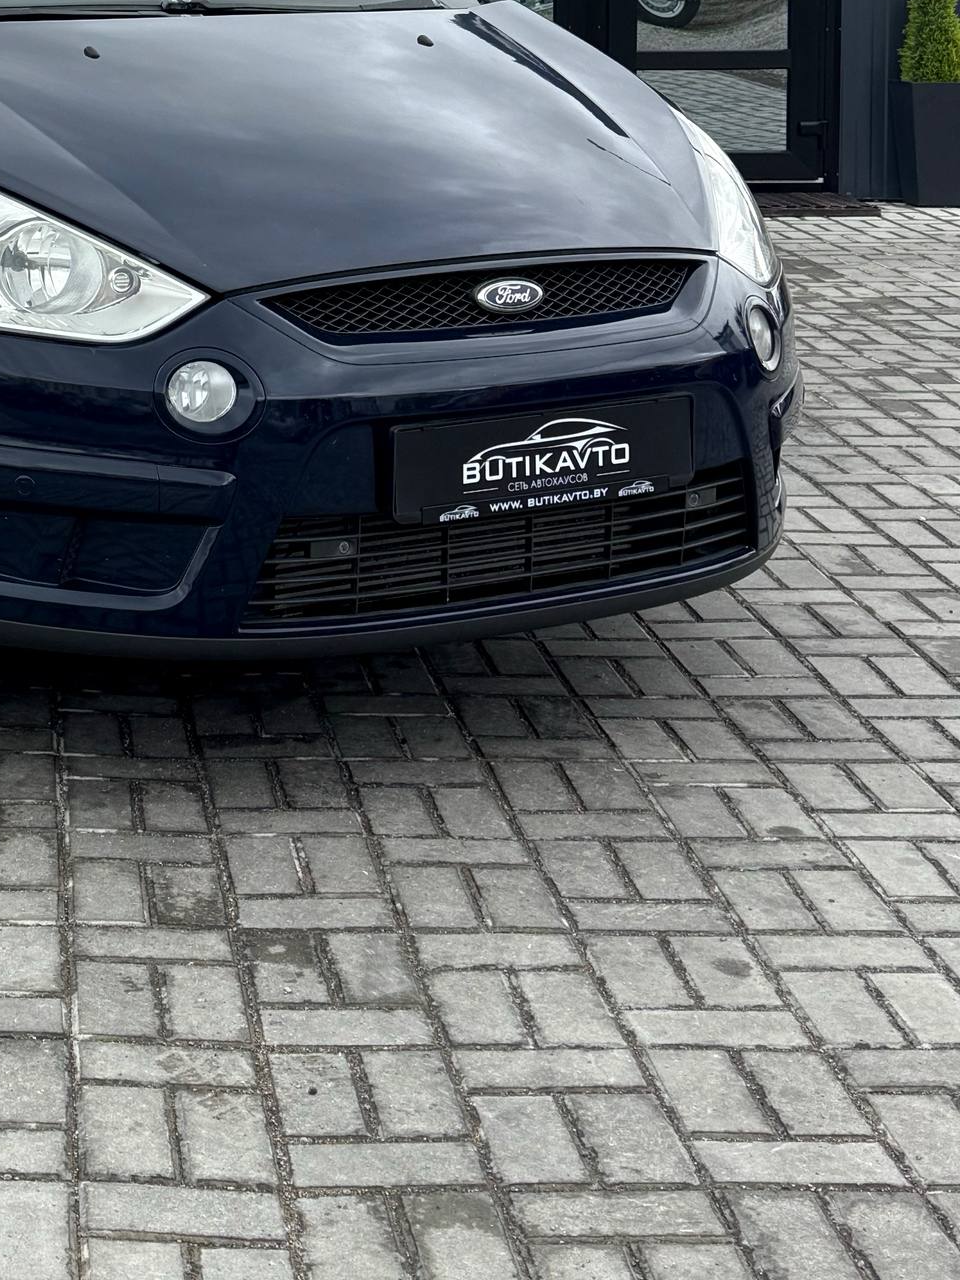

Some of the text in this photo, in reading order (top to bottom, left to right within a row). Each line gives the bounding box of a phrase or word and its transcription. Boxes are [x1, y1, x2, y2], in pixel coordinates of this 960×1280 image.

[496, 285, 531, 304] Ford
[463, 443, 630, 485] BUTIKAVTO
[507, 473, 588, 492] СЕТЬ АВТОХАУСОВ
[490, 487, 609, 513] WWW. BUTIKAVTO.BY
[440, 511, 480, 522] BUTIKAVTO
